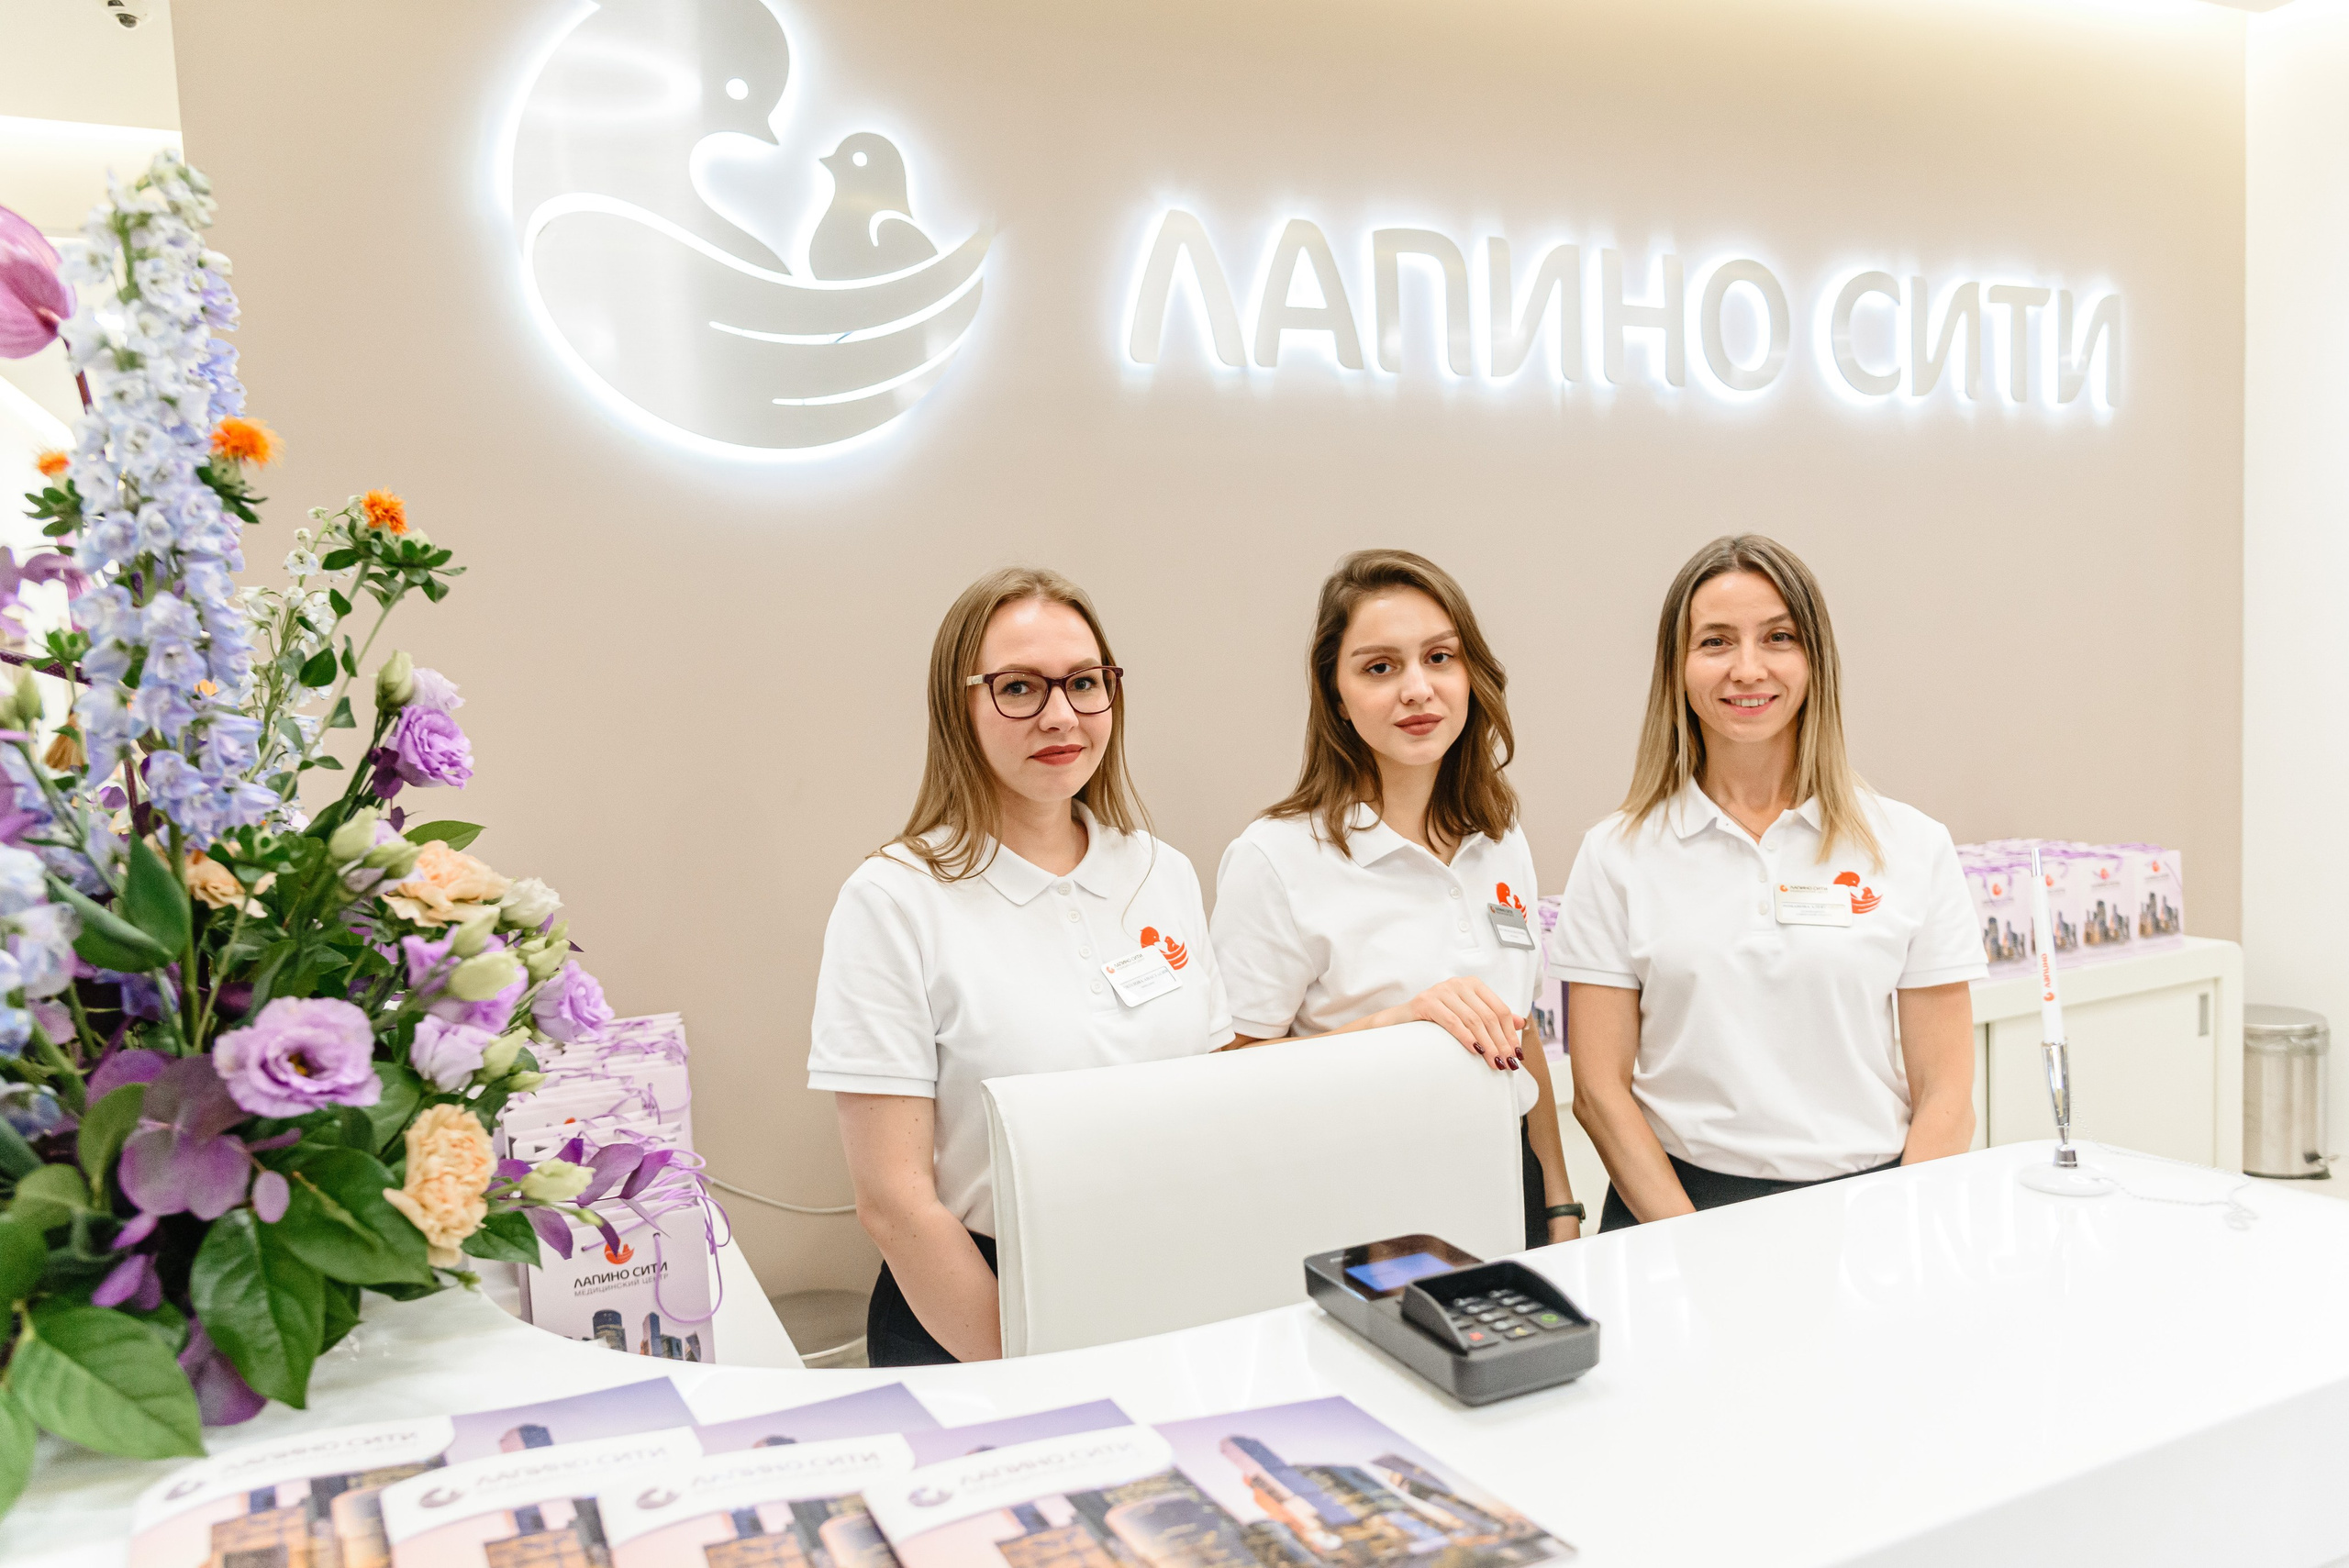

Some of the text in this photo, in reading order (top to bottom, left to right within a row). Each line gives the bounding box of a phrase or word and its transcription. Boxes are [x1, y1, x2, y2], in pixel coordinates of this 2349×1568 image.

[1129, 208, 2121, 409] ЛАПИНО СИТИ
[2041, 953, 2051, 988] ЛАПИНО
[573, 1261, 668, 1288] ЛАПИНО СИТИ
[573, 1279, 640, 1296] МЕДИЦИНСКИЙ
